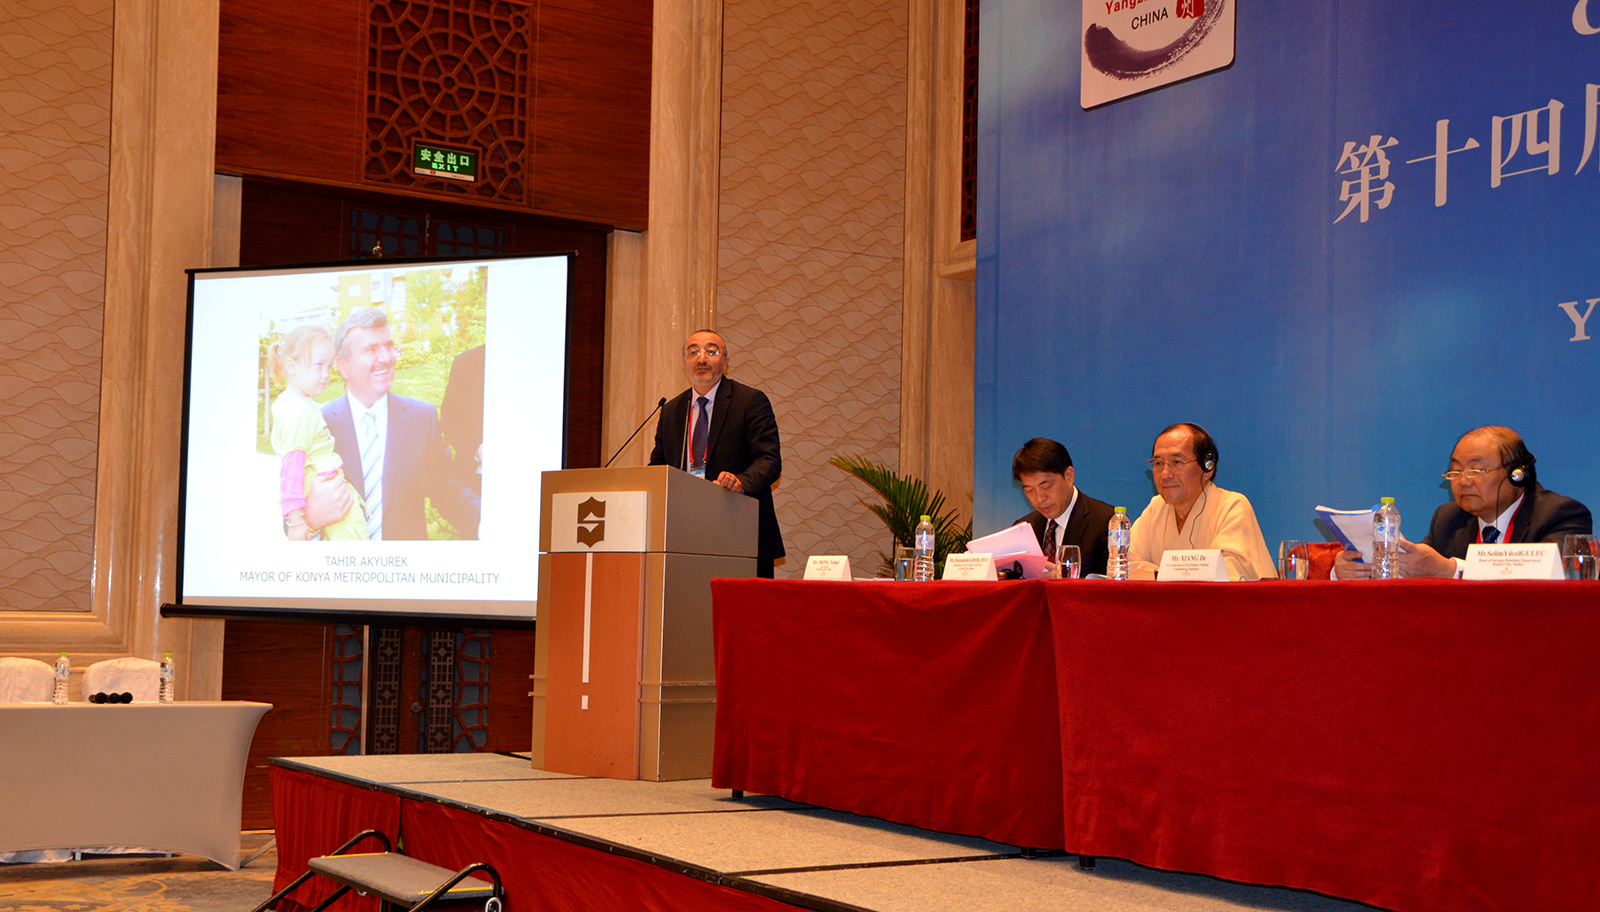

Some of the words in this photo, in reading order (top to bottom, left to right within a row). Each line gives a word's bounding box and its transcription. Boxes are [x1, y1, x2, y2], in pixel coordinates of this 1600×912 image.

[1131, 7, 1169, 30] CHINA
[420, 148, 470, 167] 安全出口
[431, 162, 459, 172] EXIT
[325, 556, 357, 566] TAHIR
[360, 556, 409, 567] AKYUREK
[239, 571, 276, 582] MAYOR
[278, 571, 292, 582] OF
[295, 572, 331, 582] KONYA
[333, 572, 416, 583] METROPOLITAN
[420, 573, 501, 584] MUNICIPALITY
